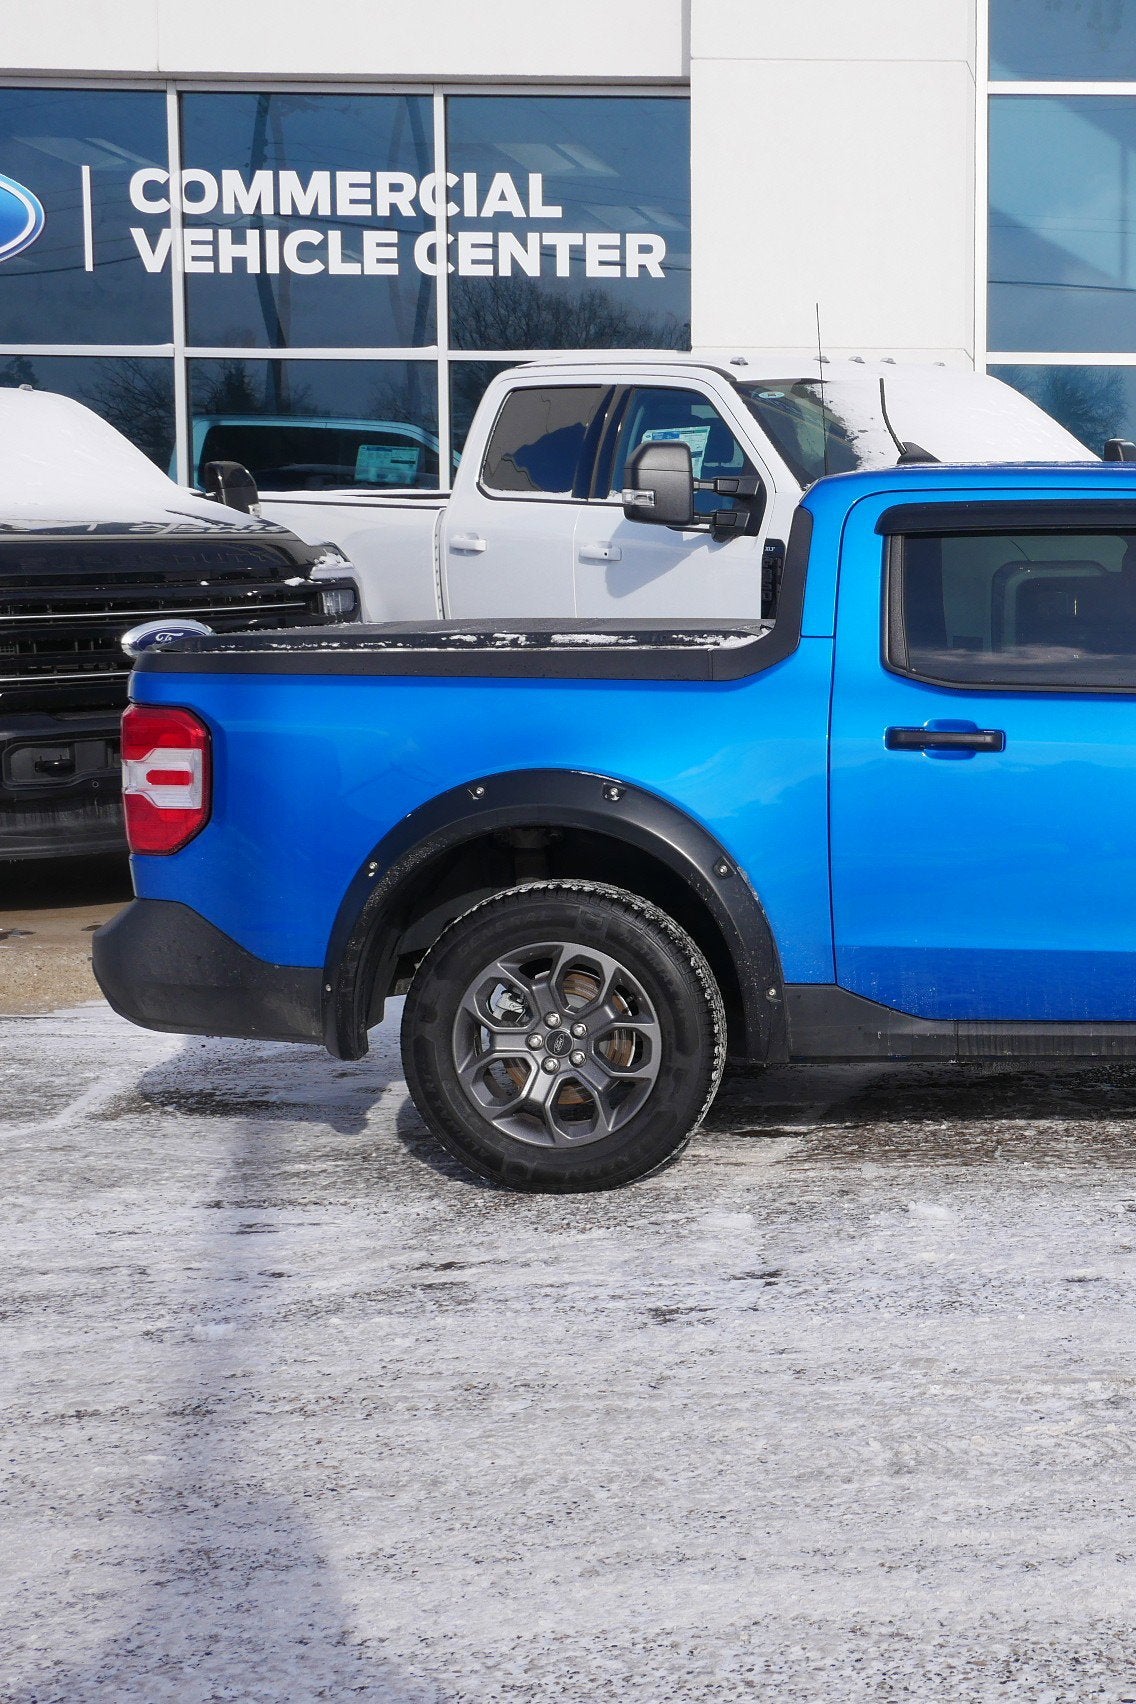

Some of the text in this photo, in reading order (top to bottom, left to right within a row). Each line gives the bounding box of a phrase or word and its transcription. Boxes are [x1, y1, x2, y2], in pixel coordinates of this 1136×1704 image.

[129, 167, 563, 218] COMMERCIAL
[129, 227, 667, 278] VEHICLE CENTER
